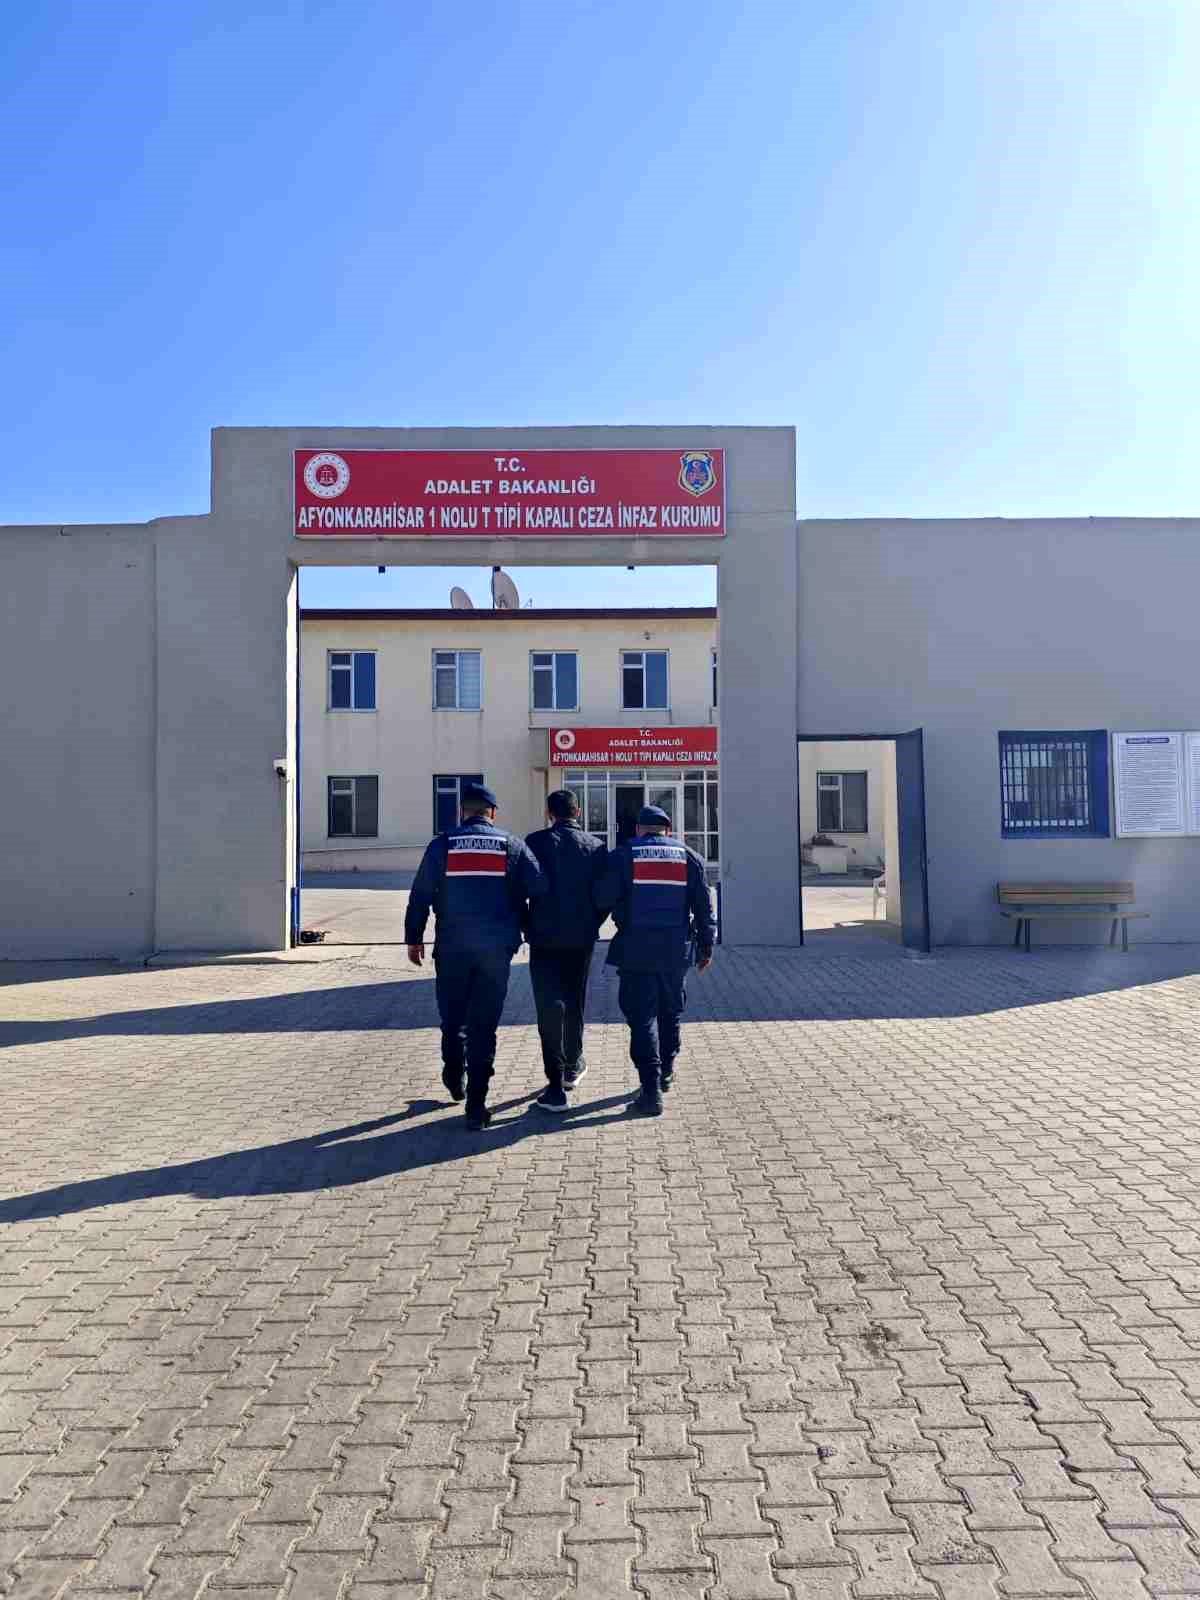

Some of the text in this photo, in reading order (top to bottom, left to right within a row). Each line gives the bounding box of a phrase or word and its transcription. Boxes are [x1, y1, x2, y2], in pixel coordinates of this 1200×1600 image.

[495, 457, 525, 471] T.C.
[424, 476, 595, 494] ADALET BAKANLIĞI
[298, 501, 721, 529] AFYONKARAHİSAR 1 NOLU T TİPİ KAPALI CEZA İNFAZ KURUMU
[615, 752, 632, 762] NOLU
[653, 751, 675, 762] KAPALI
[676, 751, 692, 762] CEZA
[455, 838, 501, 850] JANDARMA
